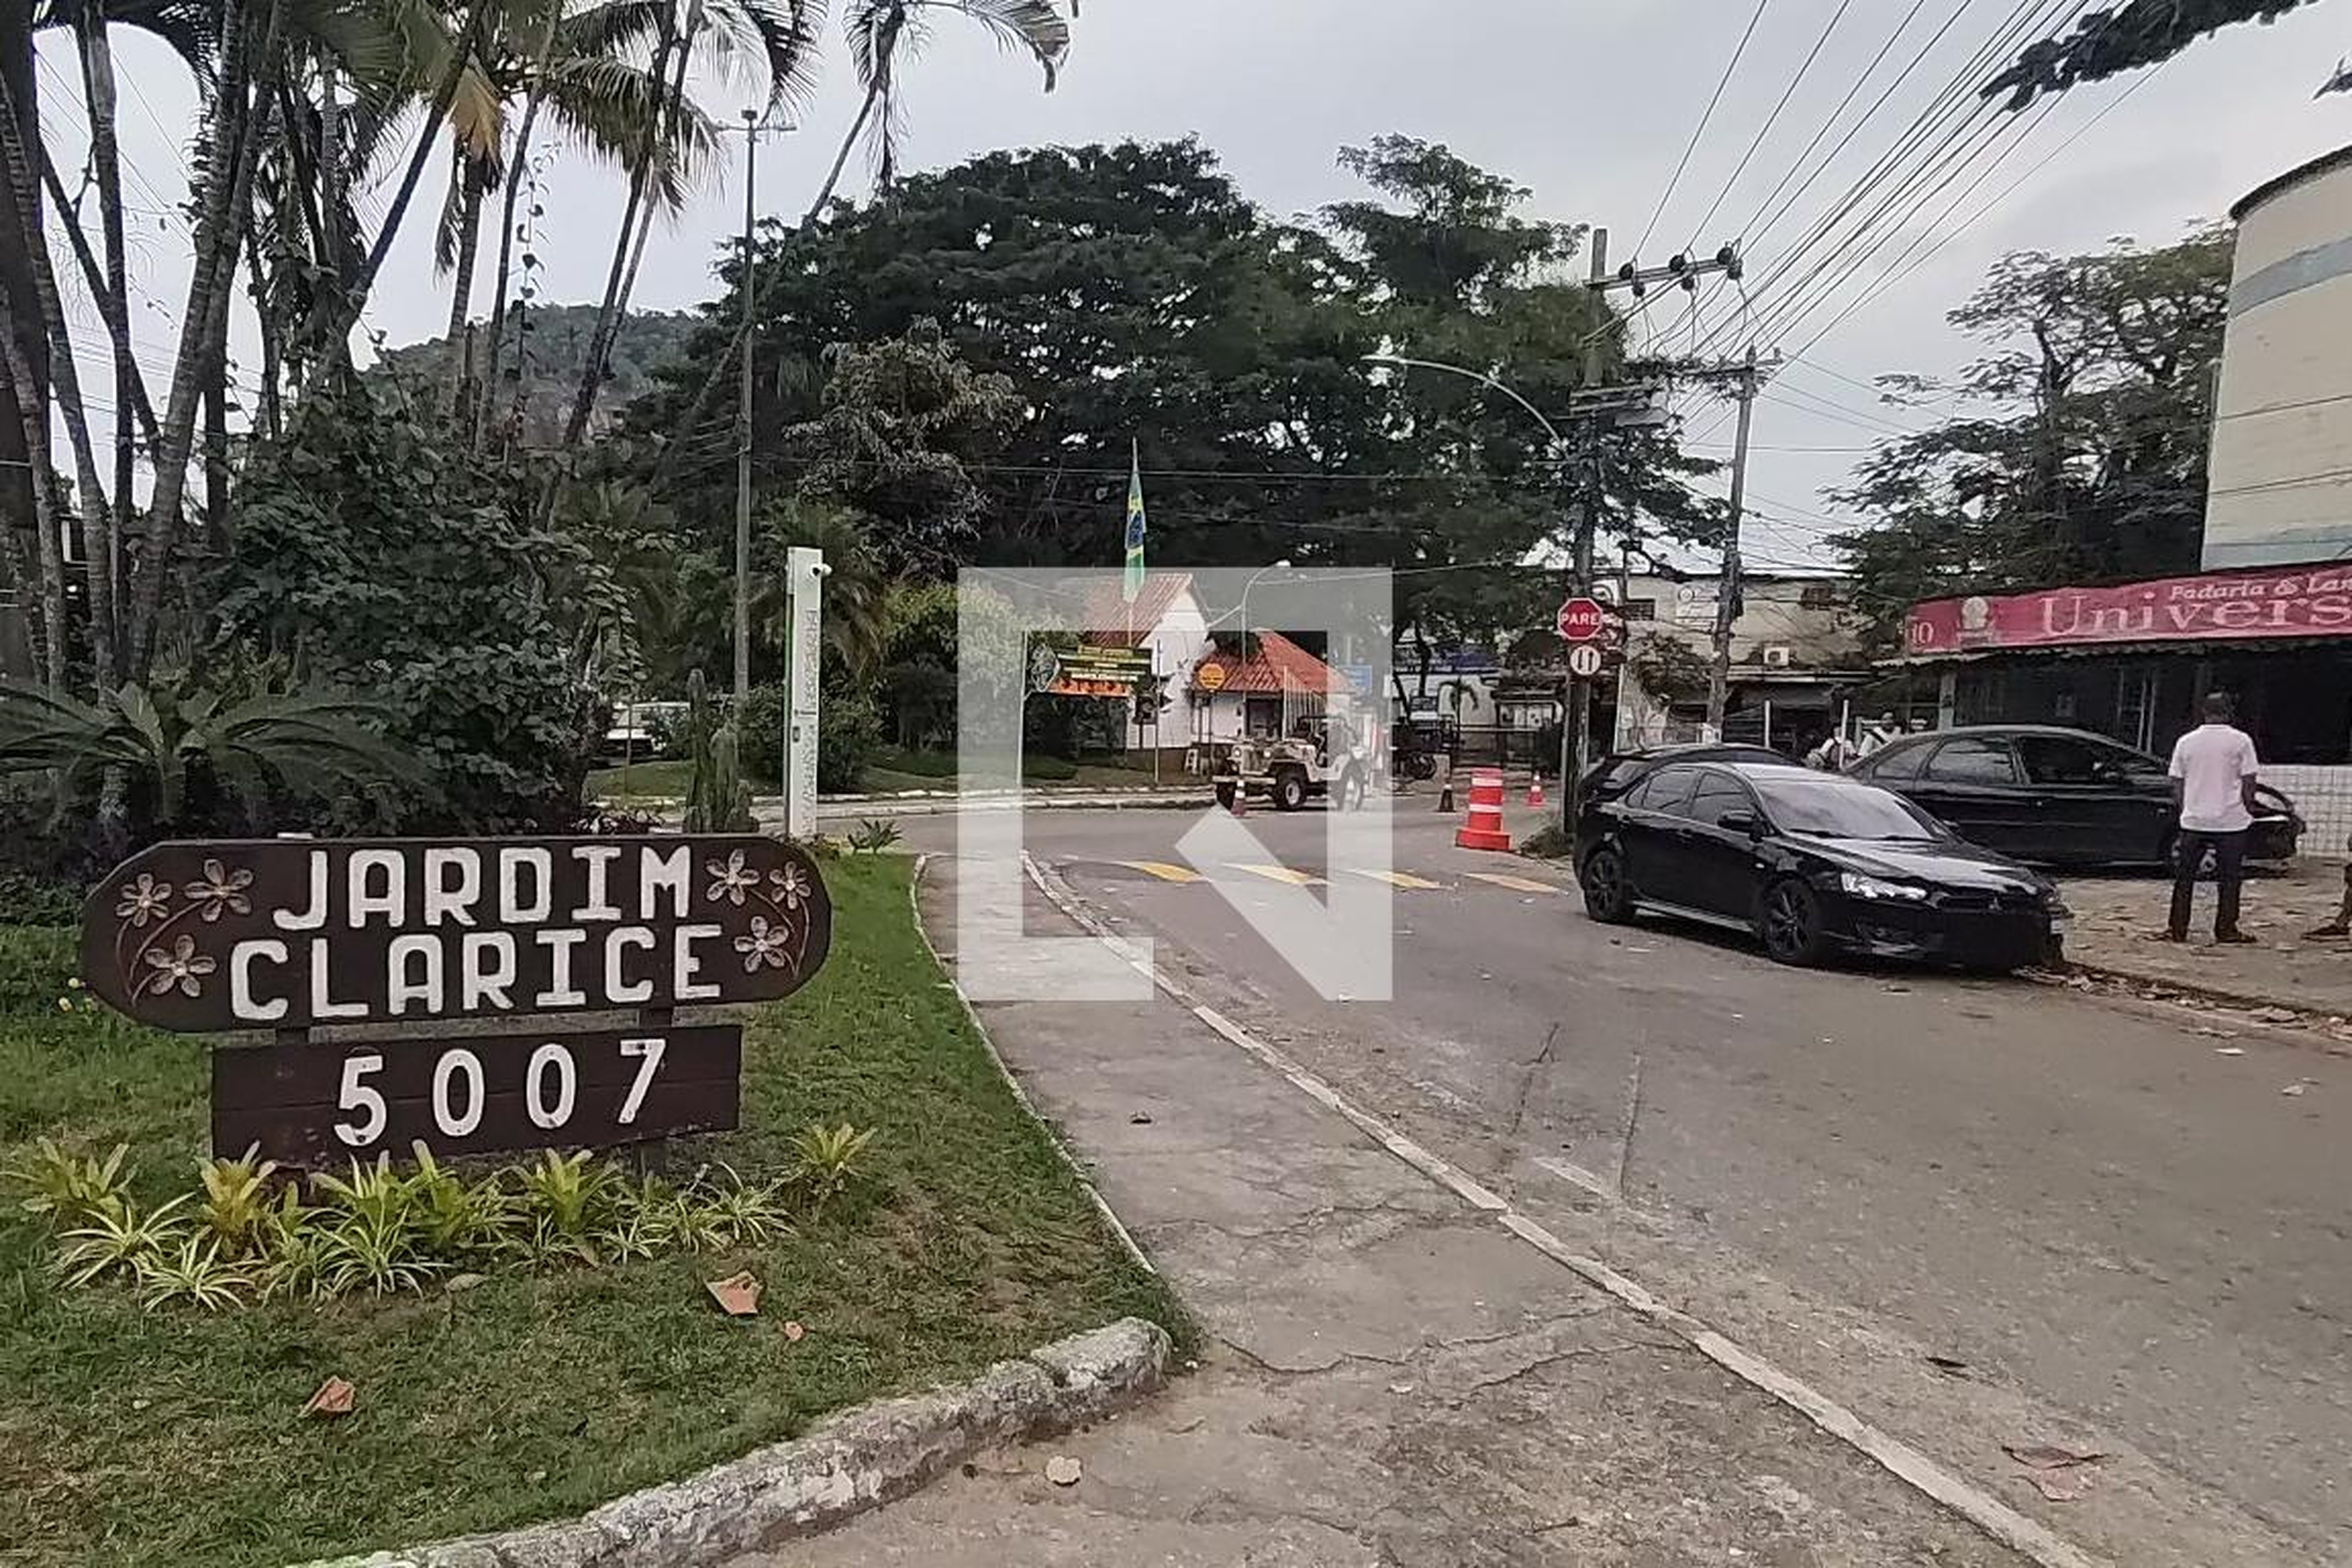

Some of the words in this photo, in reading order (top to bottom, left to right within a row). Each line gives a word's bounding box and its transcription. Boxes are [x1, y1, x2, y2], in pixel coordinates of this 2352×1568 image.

[1561, 612, 1600, 625] PARE
[2171, 581, 2266, 600] Padaria
[2275, 579, 2297, 595] &
[273, 845, 691, 931] JARDIM
[229, 924, 723, 1020] CLARICE
[333, 1038, 668, 1147] 5007
